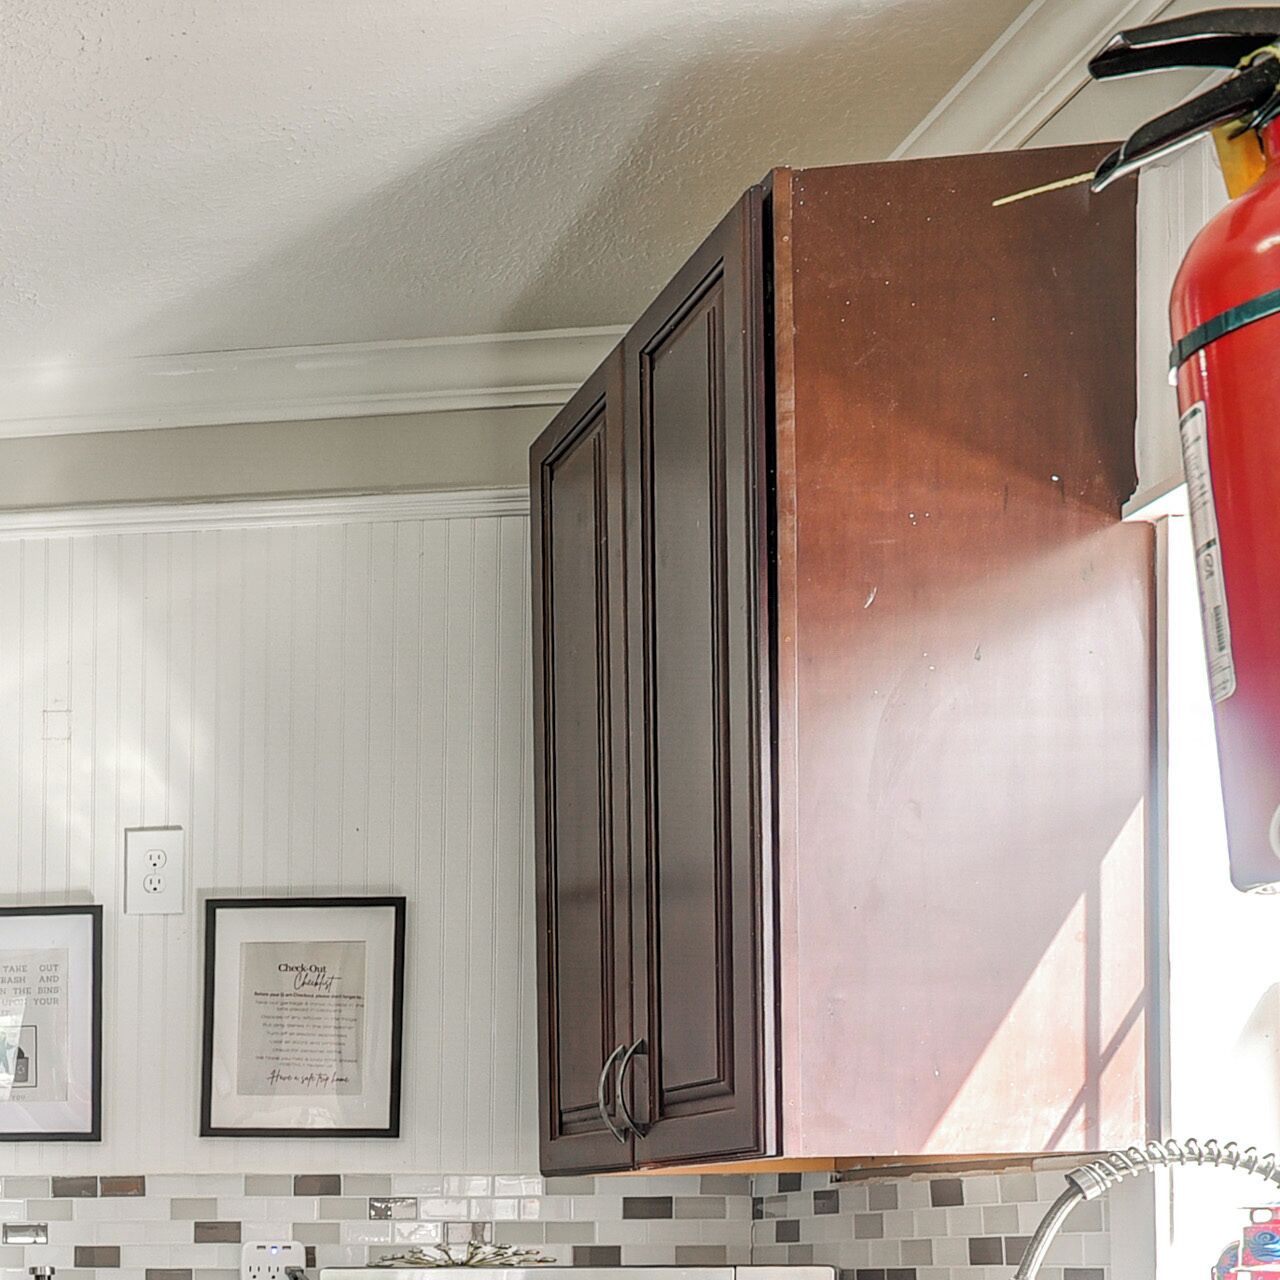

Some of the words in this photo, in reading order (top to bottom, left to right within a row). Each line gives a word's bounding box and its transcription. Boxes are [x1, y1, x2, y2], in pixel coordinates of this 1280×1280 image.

[3, 965, 28, 973] TAKE
[39, 964, 59, 972] OUT
[278, 963, 327, 973] Check-Out
[39, 975, 59, 983] AND
[13, 987, 31, 995] THE
[37, 986, 59, 994] BINS
[33, 998, 60, 1006] YOUR
[266, 1069, 292, 1086] Have
